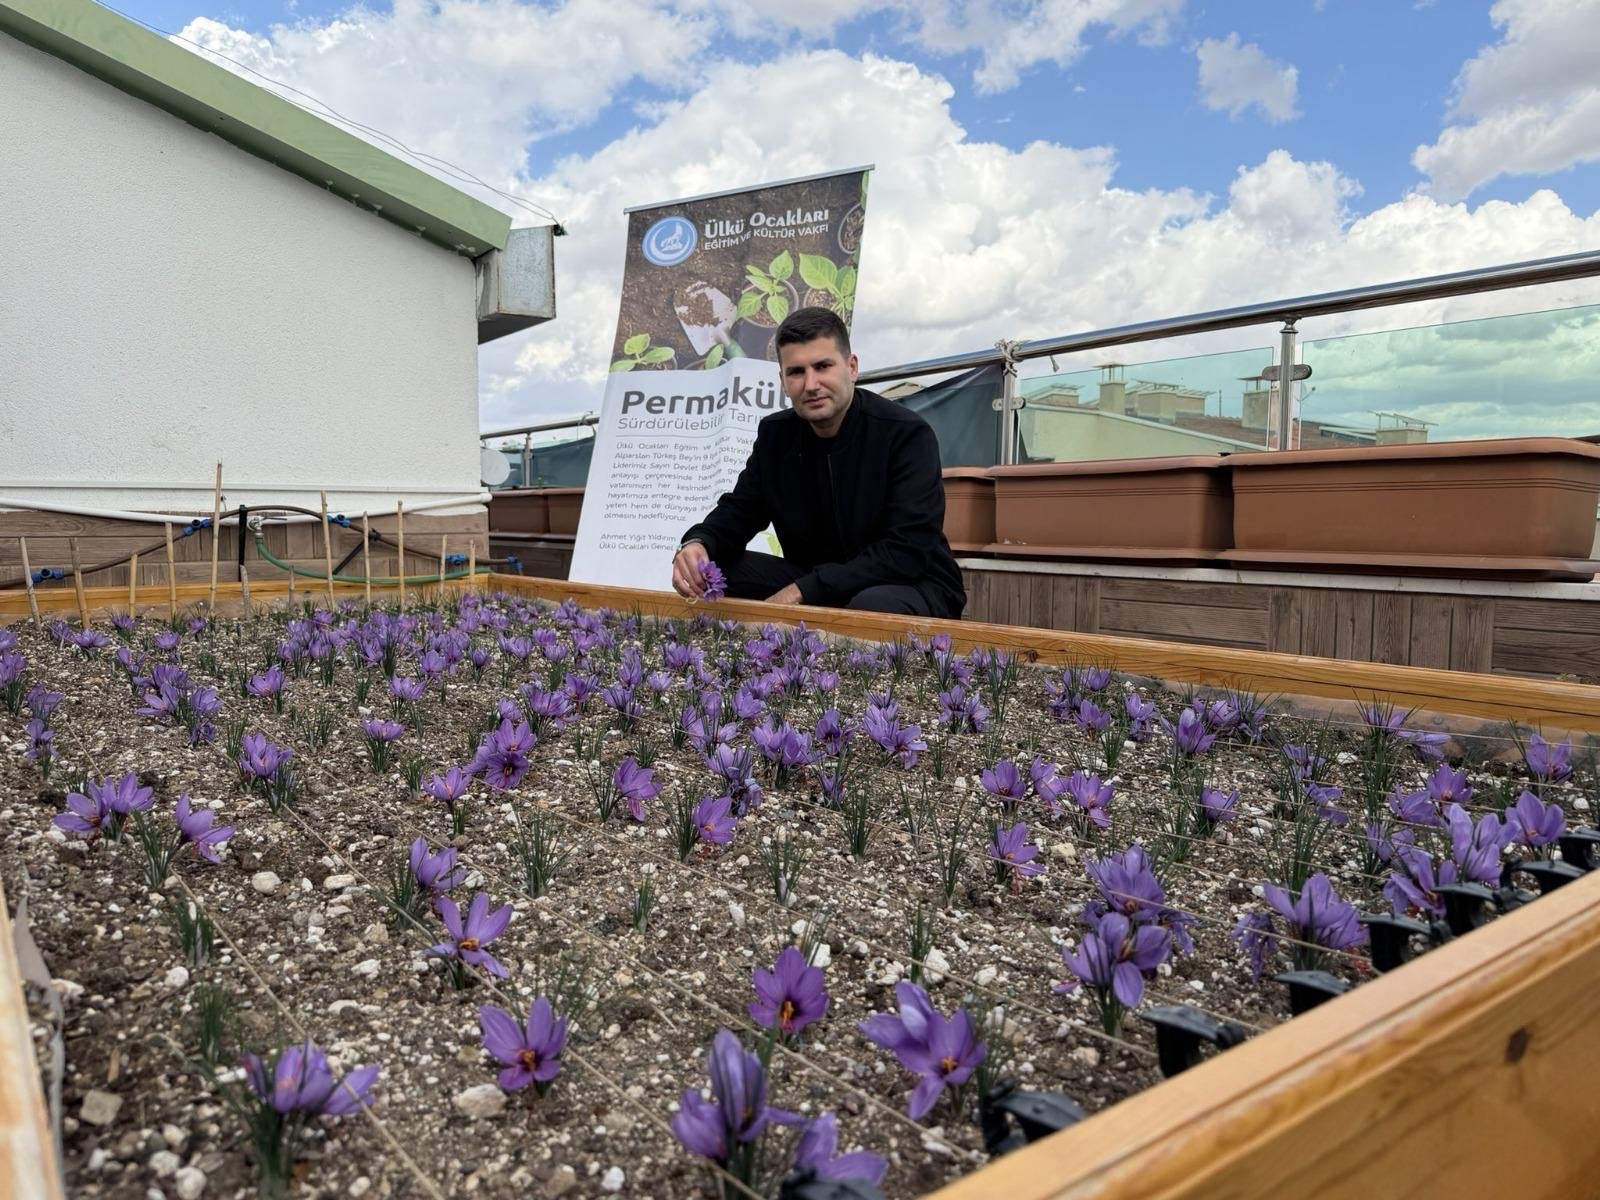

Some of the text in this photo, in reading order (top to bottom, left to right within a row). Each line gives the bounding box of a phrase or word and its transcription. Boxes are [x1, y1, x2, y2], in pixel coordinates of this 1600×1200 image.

[704, 218, 745, 239] Ülkü
[704, 237, 739, 251] EĞİTİM
[740, 230, 752, 243] VE
[753, 227, 795, 239] KÜLTÜR
[621, 376, 789, 416] Permakül
[617, 407, 763, 431] Sürdürülebilir Tarı
[601, 533, 627, 541] Ahmet
